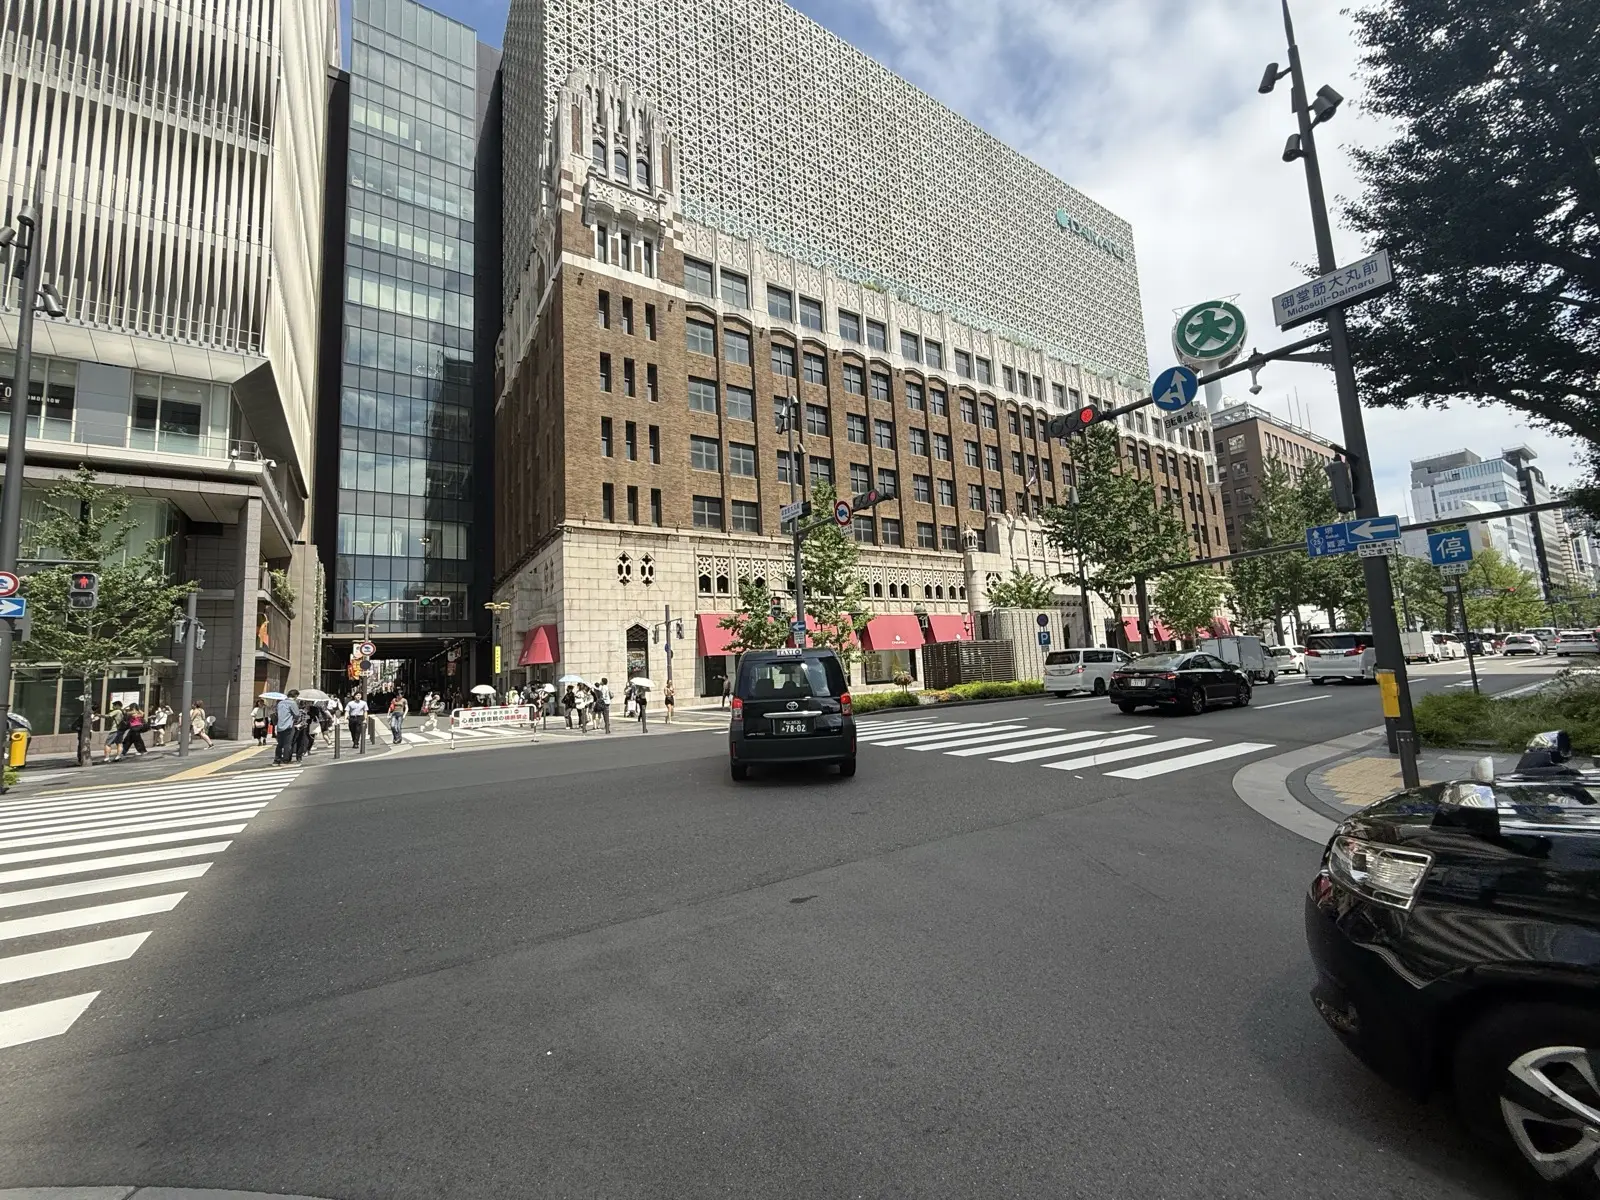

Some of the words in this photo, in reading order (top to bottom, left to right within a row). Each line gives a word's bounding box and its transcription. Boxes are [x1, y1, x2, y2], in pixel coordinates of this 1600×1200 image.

[1281, 260, 1379, 310] 御堂筋大丸前
[1287, 278, 1375, 317] Midosuji-Daimaru
[1165, 411, 1199, 428] 自転車を除く
[1360, 548, 1392, 556] ここまで
[1436, 537, 1466, 559] 停
[1041, 633, 1048, 644] P
